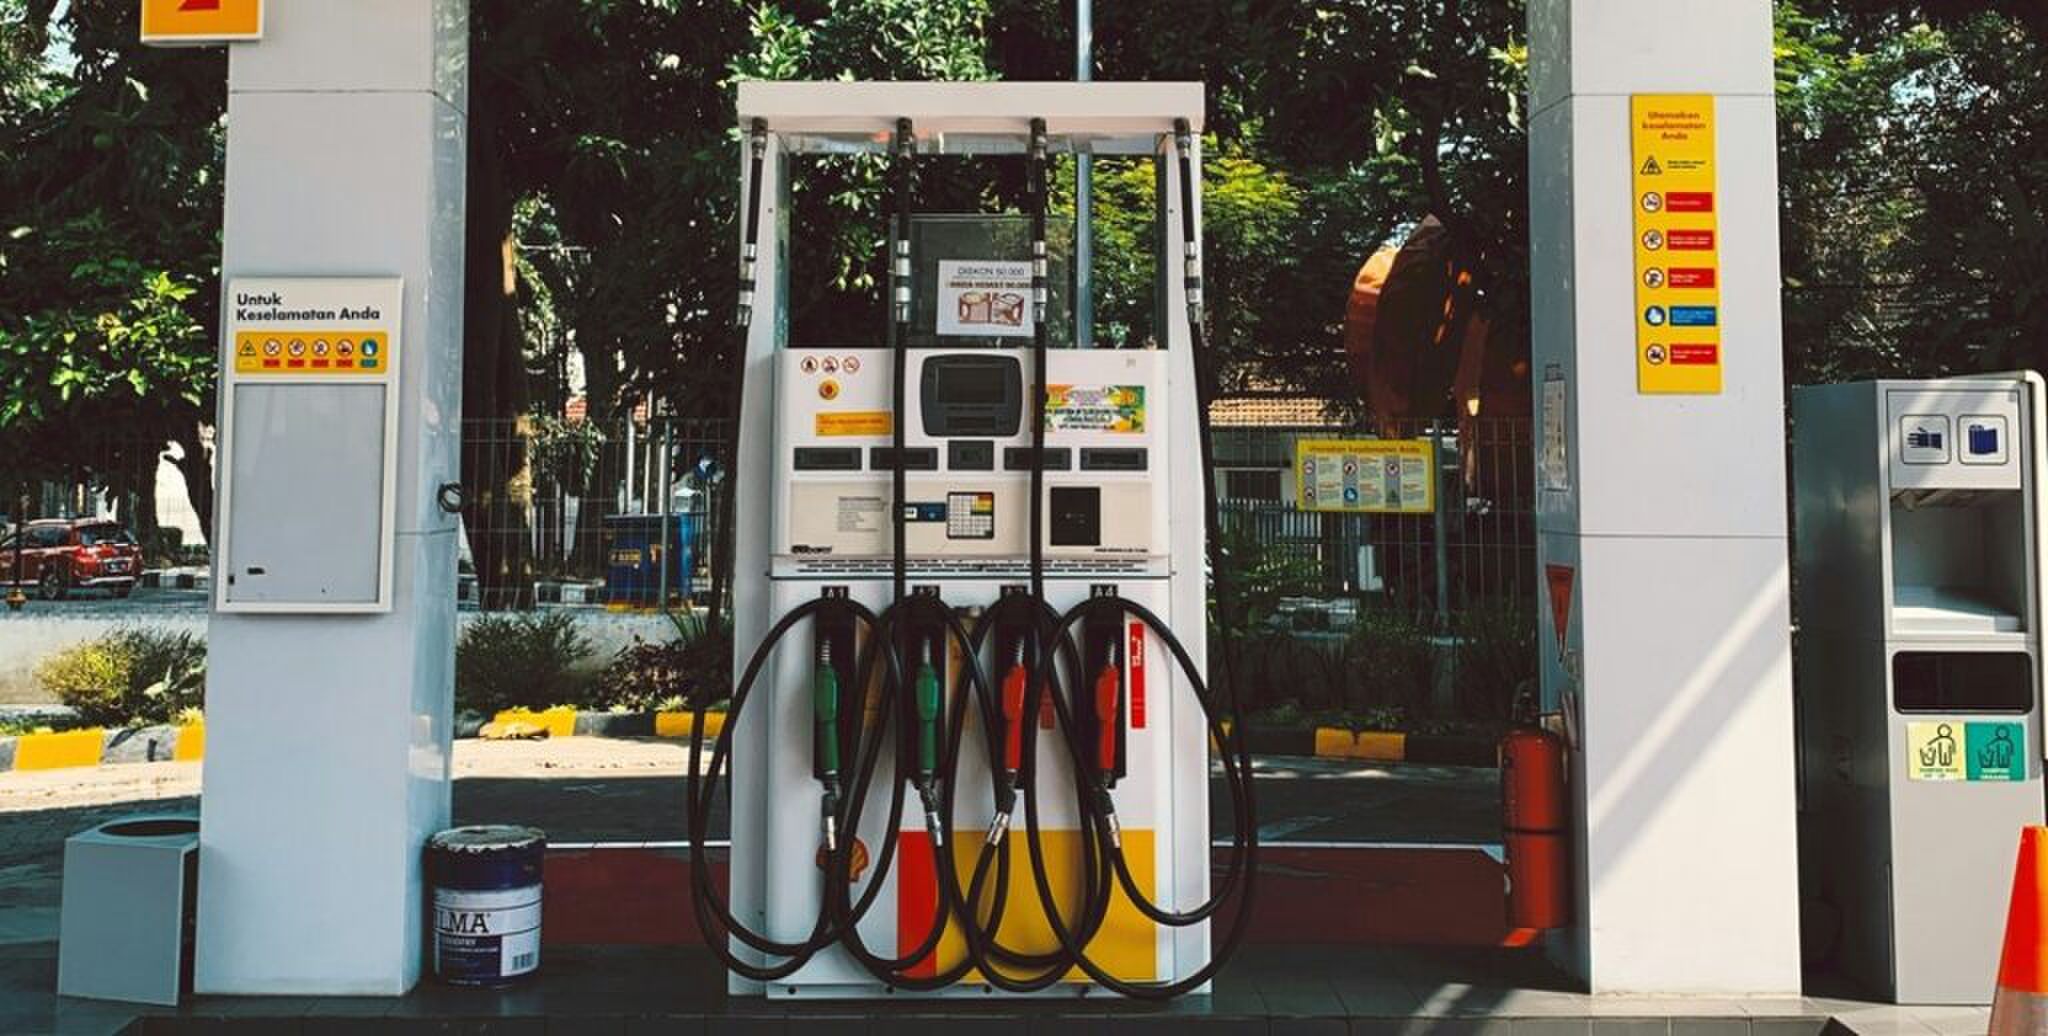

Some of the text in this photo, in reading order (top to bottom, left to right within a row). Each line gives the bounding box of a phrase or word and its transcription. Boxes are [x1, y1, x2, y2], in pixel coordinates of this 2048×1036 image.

[237, 292, 282, 305] Untuk
[236, 306, 380, 321] Keselamatan Anda
